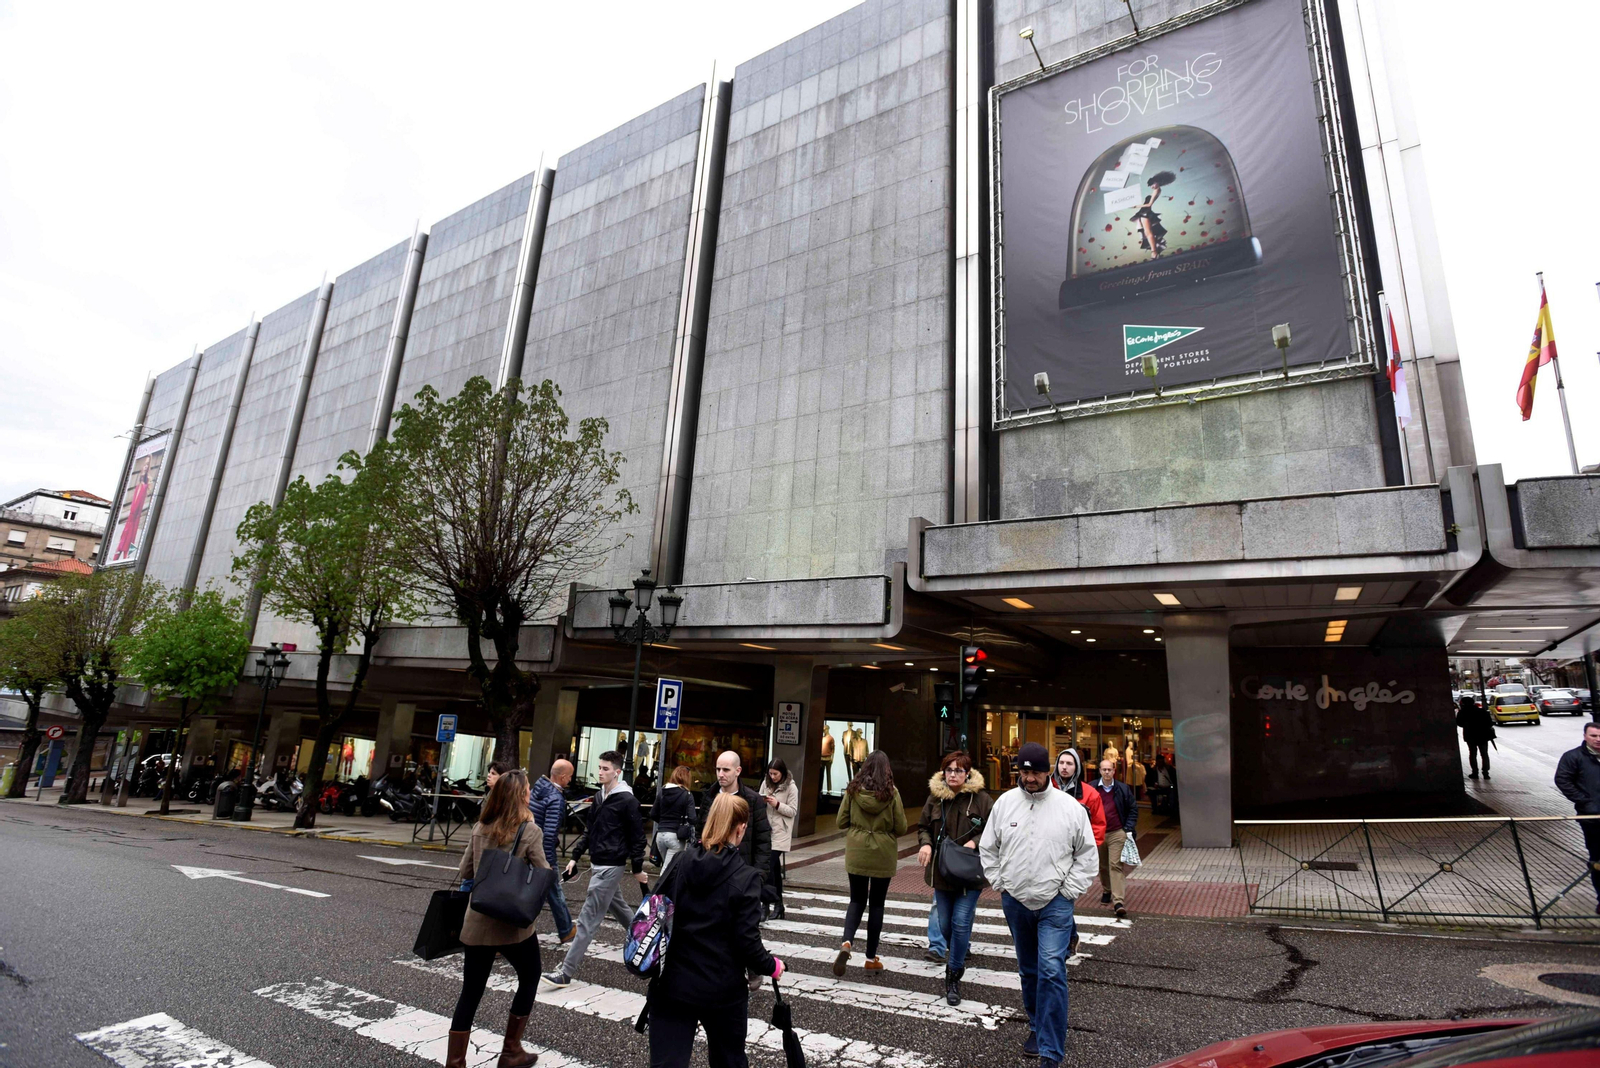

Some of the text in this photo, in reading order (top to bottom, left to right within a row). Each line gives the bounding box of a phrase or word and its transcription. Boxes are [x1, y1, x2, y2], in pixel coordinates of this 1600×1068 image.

[1117, 54, 1158, 82] FOR
[1064, 52, 1222, 124] SHOPPING
[1086, 69, 1212, 134] LOVERS
[1111, 194, 1135, 204] FASHION
[1099, 257, 1213, 291] Greetings from SPAIN
[1135, 336, 1154, 344] Corte
[1125, 356, 1210, 375] SPAI PORTUGAL
[1179, 349, 1209, 359] STORES
[664, 688, 675, 704] P
[1240, 675, 1309, 701] Corte
[1316, 674, 1416, 711] Inglés
